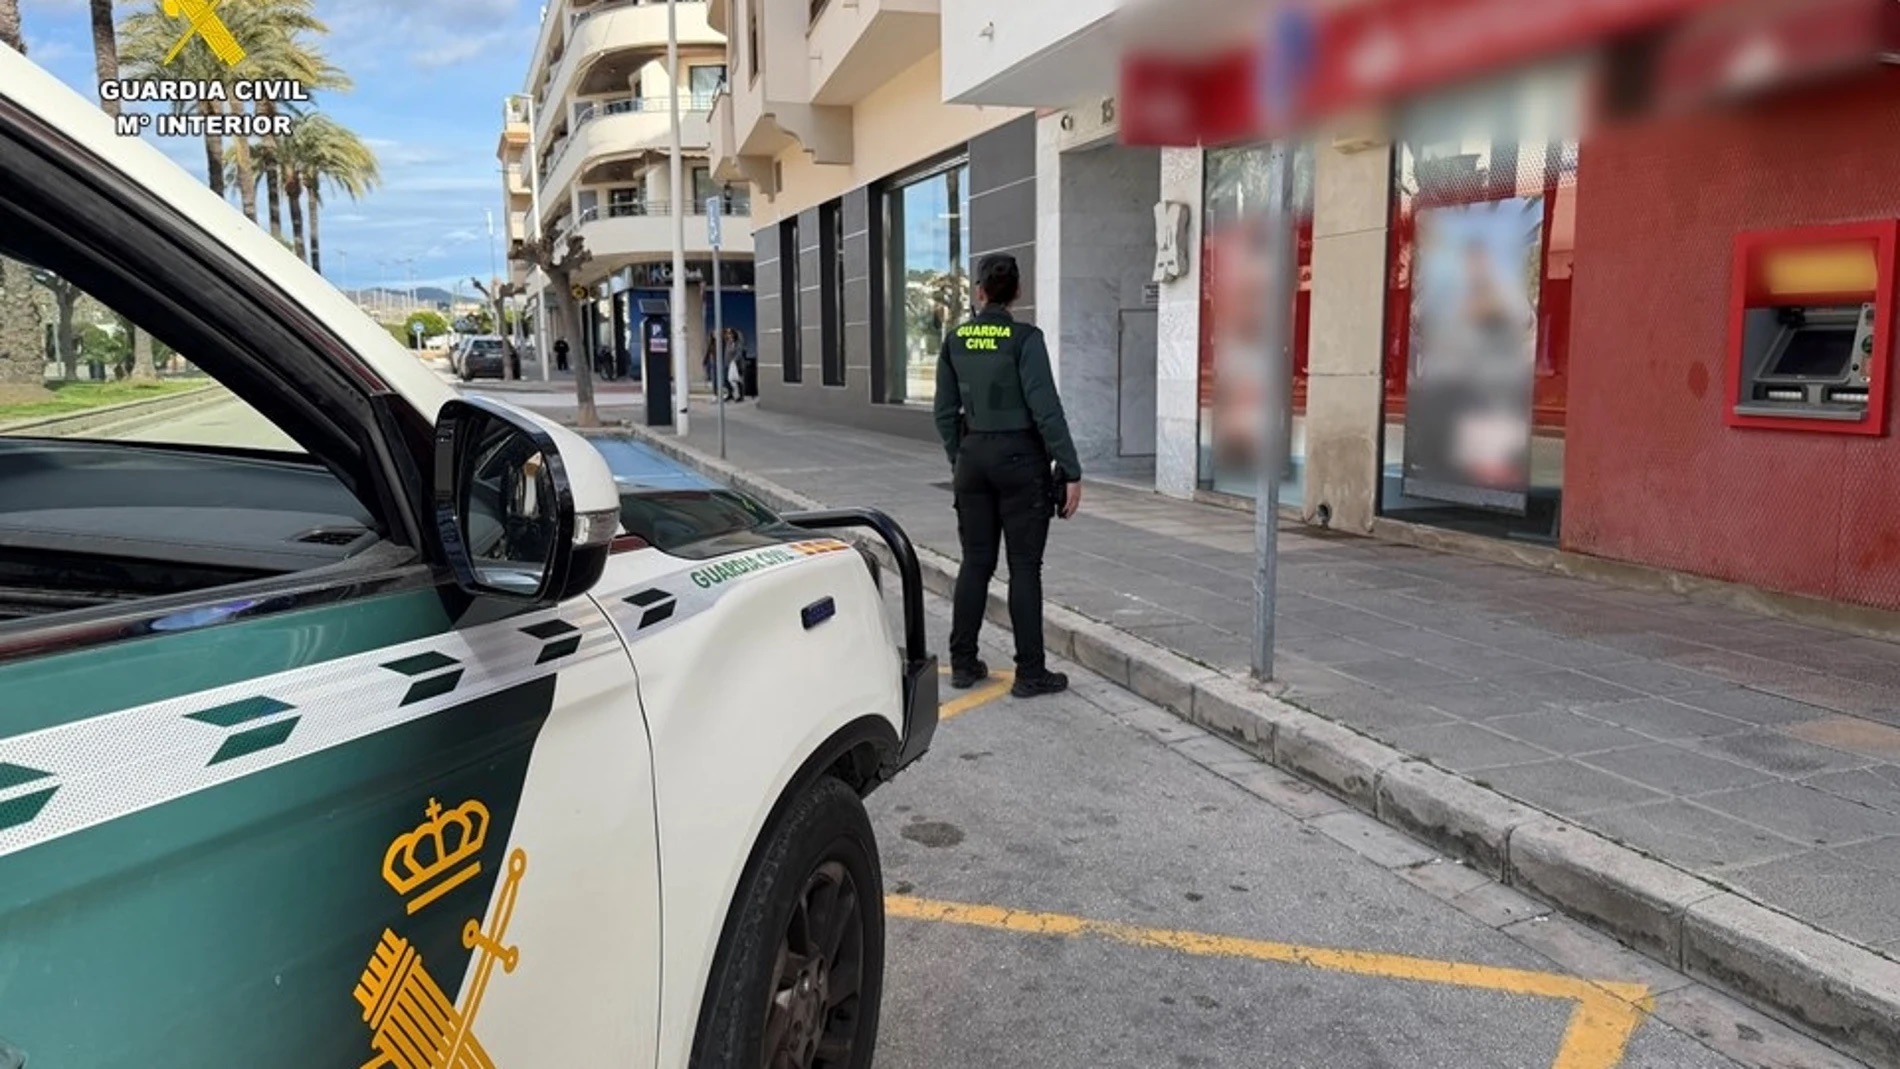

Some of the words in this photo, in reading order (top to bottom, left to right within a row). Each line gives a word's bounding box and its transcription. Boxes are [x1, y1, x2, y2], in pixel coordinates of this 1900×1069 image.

[957, 326, 1010, 338] GUARDIA
[966, 338, 997, 350] CIVIL
[690, 554, 762, 589] GUARDIA
[760, 548, 795, 566] CIVIL
